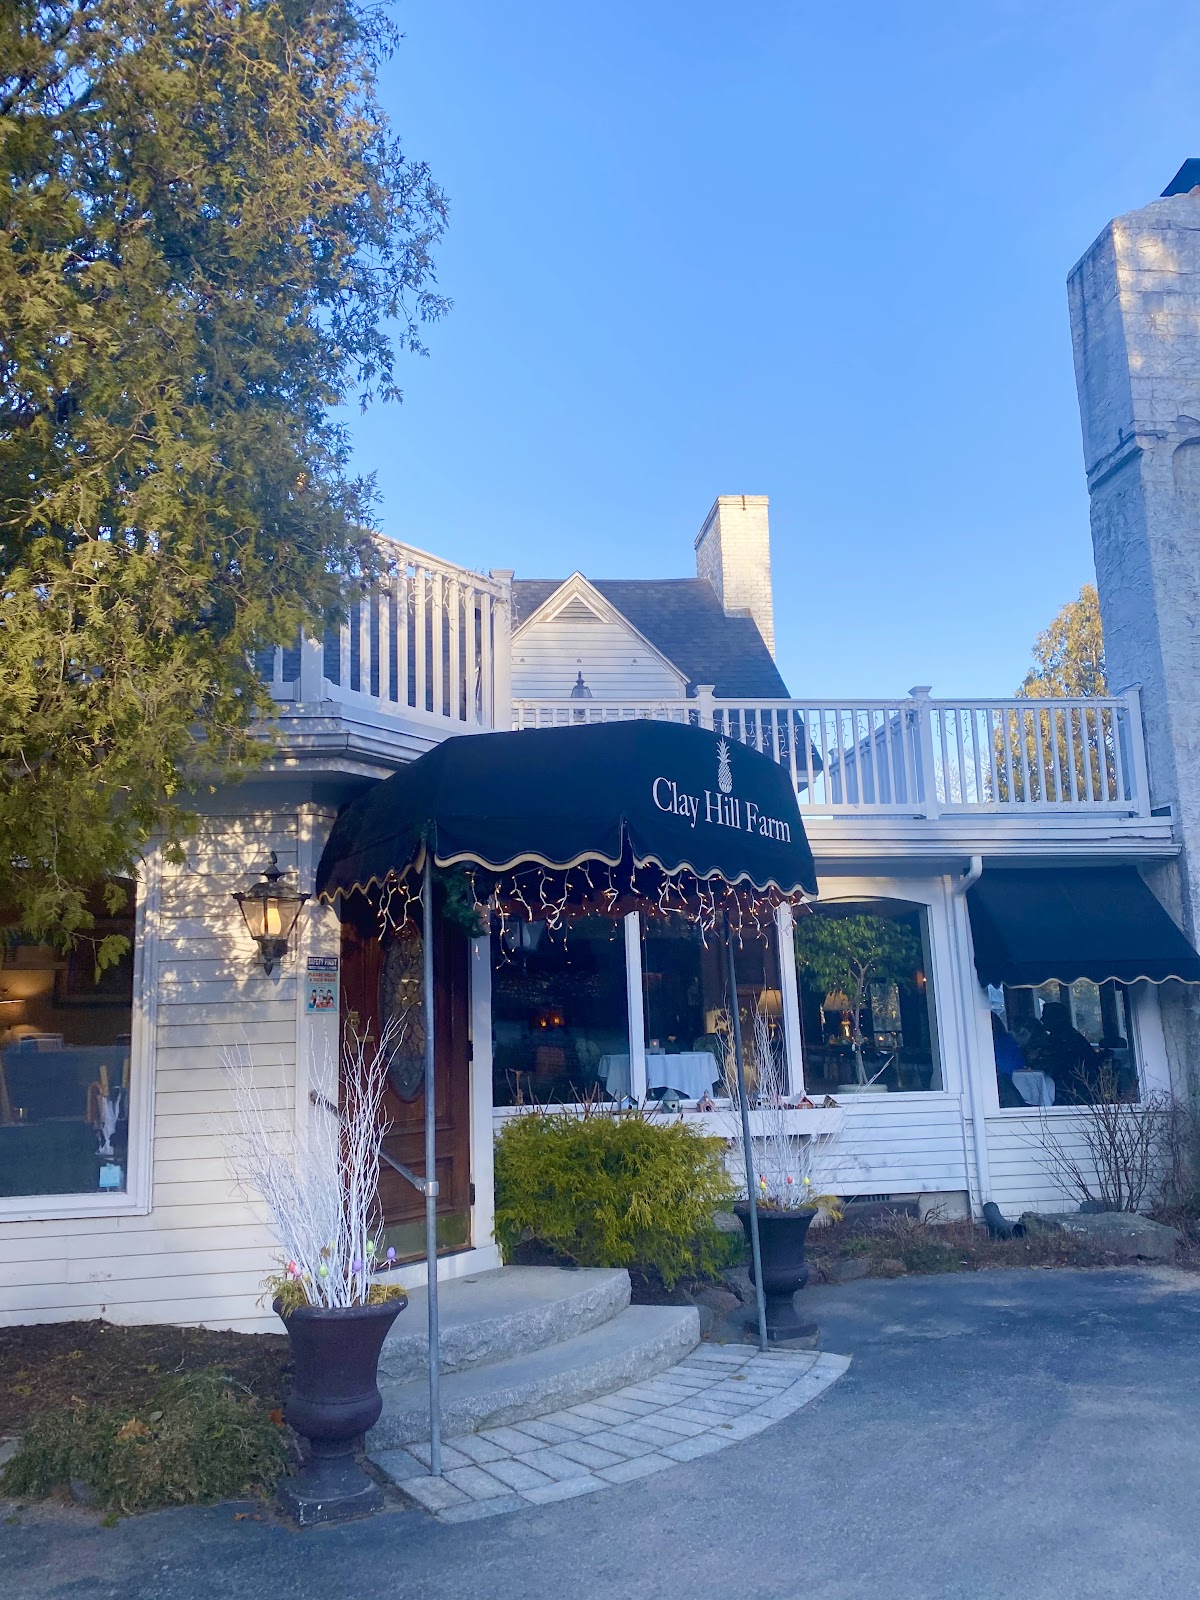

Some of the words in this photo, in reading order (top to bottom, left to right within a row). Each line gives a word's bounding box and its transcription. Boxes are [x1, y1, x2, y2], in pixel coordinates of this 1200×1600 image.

[652, 777, 700, 828] Clay
[704, 789, 742, 829] Hill
[745, 801, 792, 843] Farm
